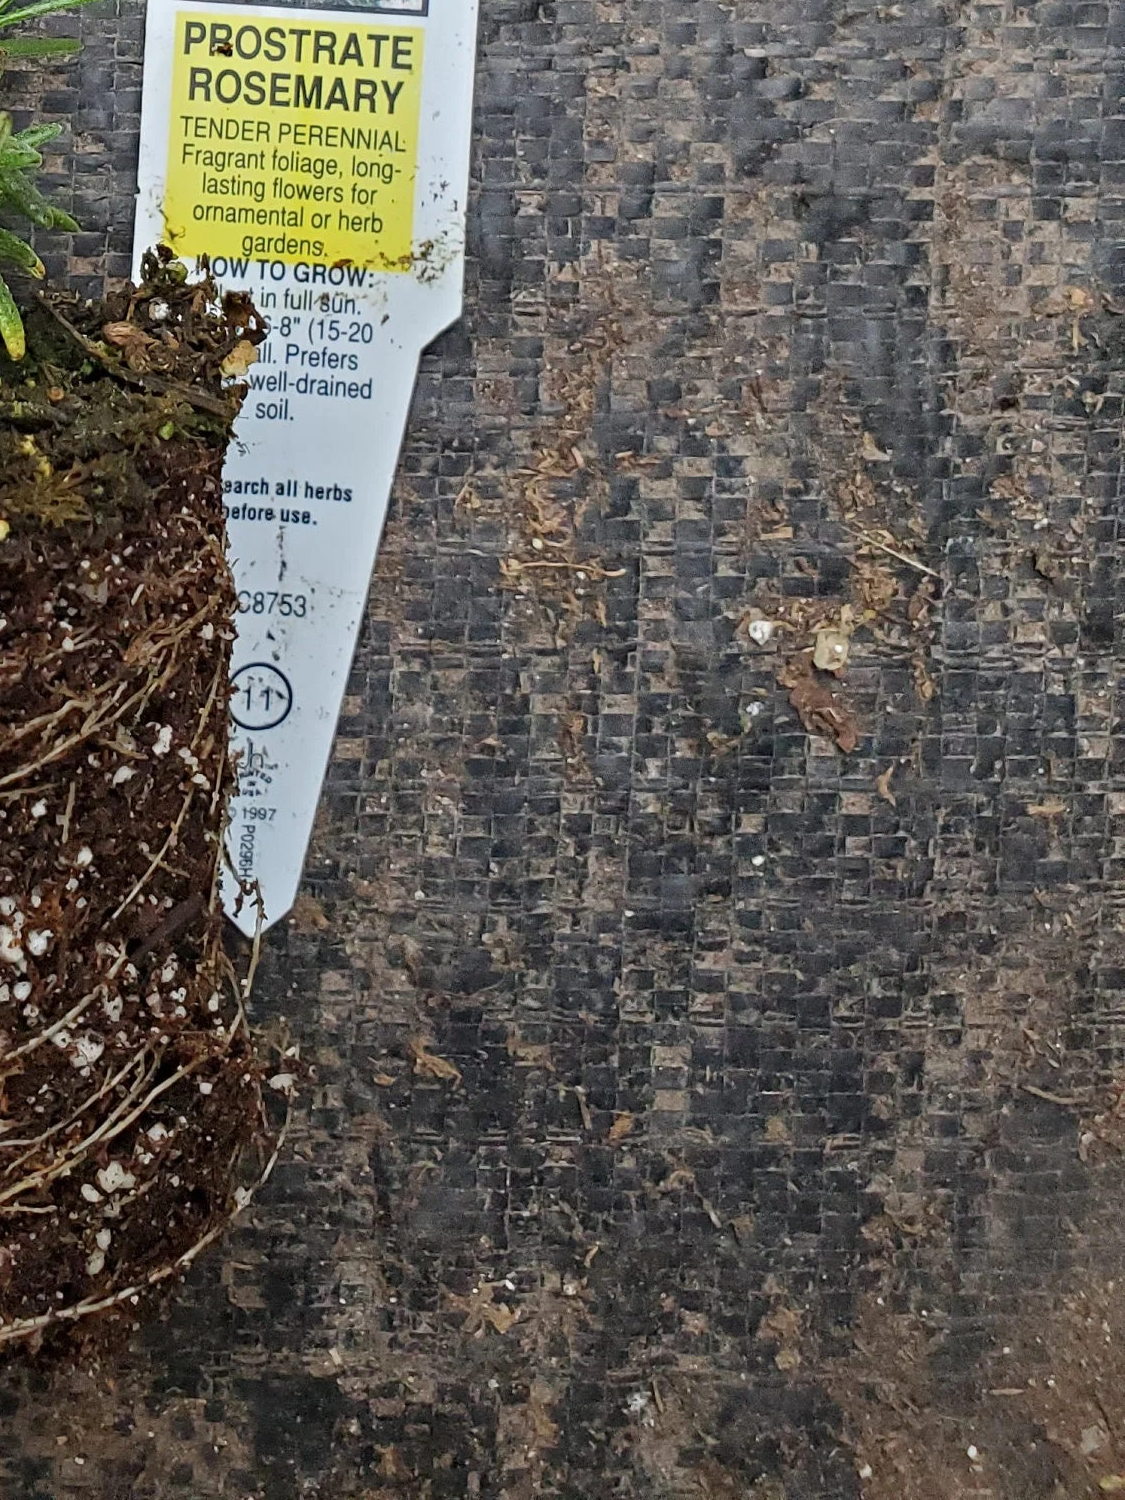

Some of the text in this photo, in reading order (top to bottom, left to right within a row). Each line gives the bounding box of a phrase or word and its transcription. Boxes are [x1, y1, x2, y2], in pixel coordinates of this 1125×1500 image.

[184, 21, 413, 70] PROSTRATE
[188, 66, 404, 114] ROSEMARY
[180, 115, 406, 152] TENDER PERENNIAL
[182, 143, 402, 184] Fragrant foliage, long-
[202, 173, 377, 205] lasting flowers for
[192, 204, 383, 234] ornamental or herb
[242, 231, 328, 258] gardens.
[256, 259, 285, 281] TO
[295, 261, 375, 288] GROW:
[260, 286, 277, 309] in
[284, 287, 313, 311] full
[320, 294, 362, 315] sun.
[308, 318, 373, 344] (15-20
[285, 343, 359, 371] Prefers
[249, 372, 373, 400] well-drained
[255, 402, 294, 421] soil.
[223, 477, 353, 503] earch all herbs
[280, 507, 318, 526] use.
[243, 685, 272, 711] 11
[241, 807, 276, 821] 1997
[238, 824, 256, 879] P0296H
